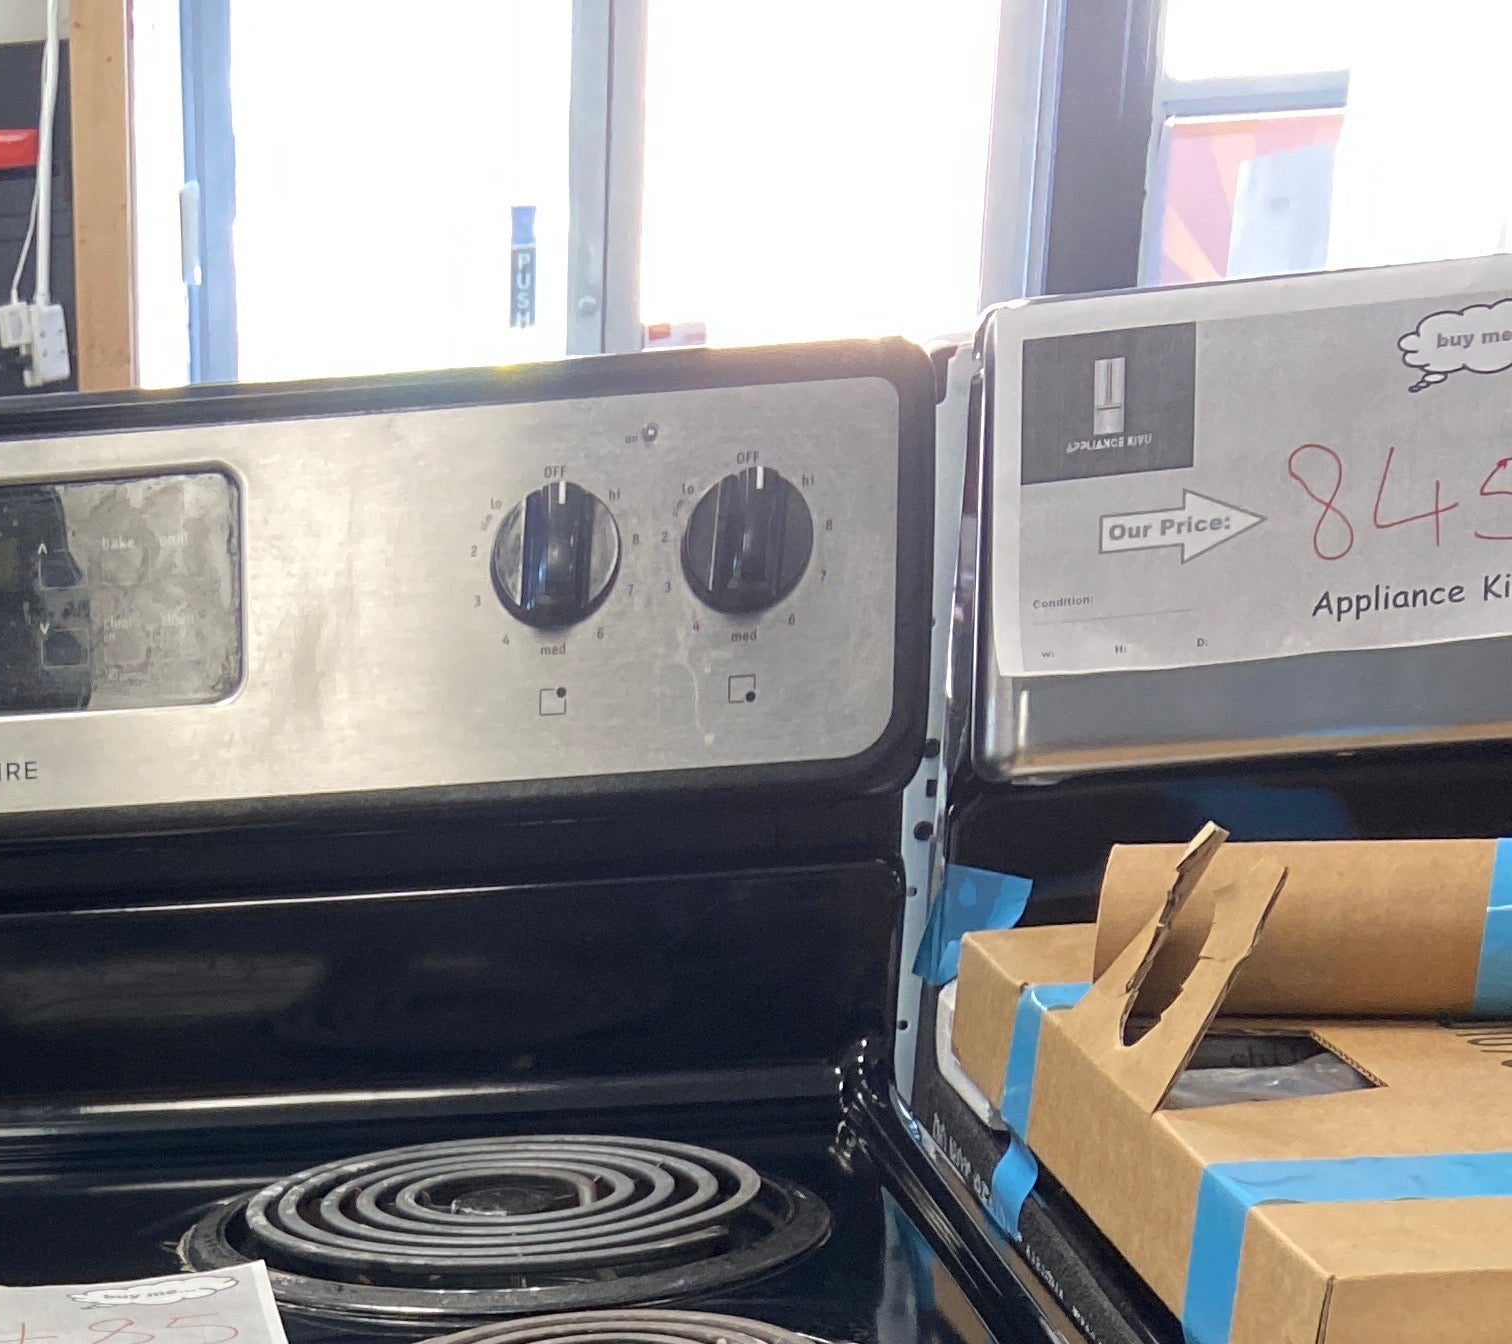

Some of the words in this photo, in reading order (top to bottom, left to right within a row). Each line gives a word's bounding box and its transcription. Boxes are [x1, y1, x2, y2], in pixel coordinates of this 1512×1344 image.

[516, 252, 531, 326] PUSH
[1437, 332, 1474, 349] buy
[625, 435, 638, 444] on
[1066, 434, 1124, 454] APPLIANCE
[1126, 432, 1154, 448] KIVU
[737, 451, 760, 464] OFF
[544, 466, 567, 479] OFF
[802, 475, 814, 486] hi
[608, 488, 621, 501] hi
[682, 483, 695, 495] lo
[490, 497, 502, 509] lo
[825, 520, 833, 531] 8
[1108, 522, 1153, 541] Our
[1160, 515, 1231, 537] Price:
[632, 533, 640, 545] 8
[661, 531, 668, 543] 2
[470, 546, 477, 557] 2
[820, 570, 827, 582] 7
[628, 584, 634, 596] 7
[664, 581, 671, 593] 3
[473, 595, 481, 608] 3
[1032, 596, 1094, 609] Condition:
[1312, 584, 1466, 622] Appliance
[788, 614, 796, 625] 6
[692, 620, 700, 632] 4
[502, 634, 510, 645] 4
[596, 627, 604, 640] 6
[731, 630, 757, 642] med
[540, 644, 566, 656] med
